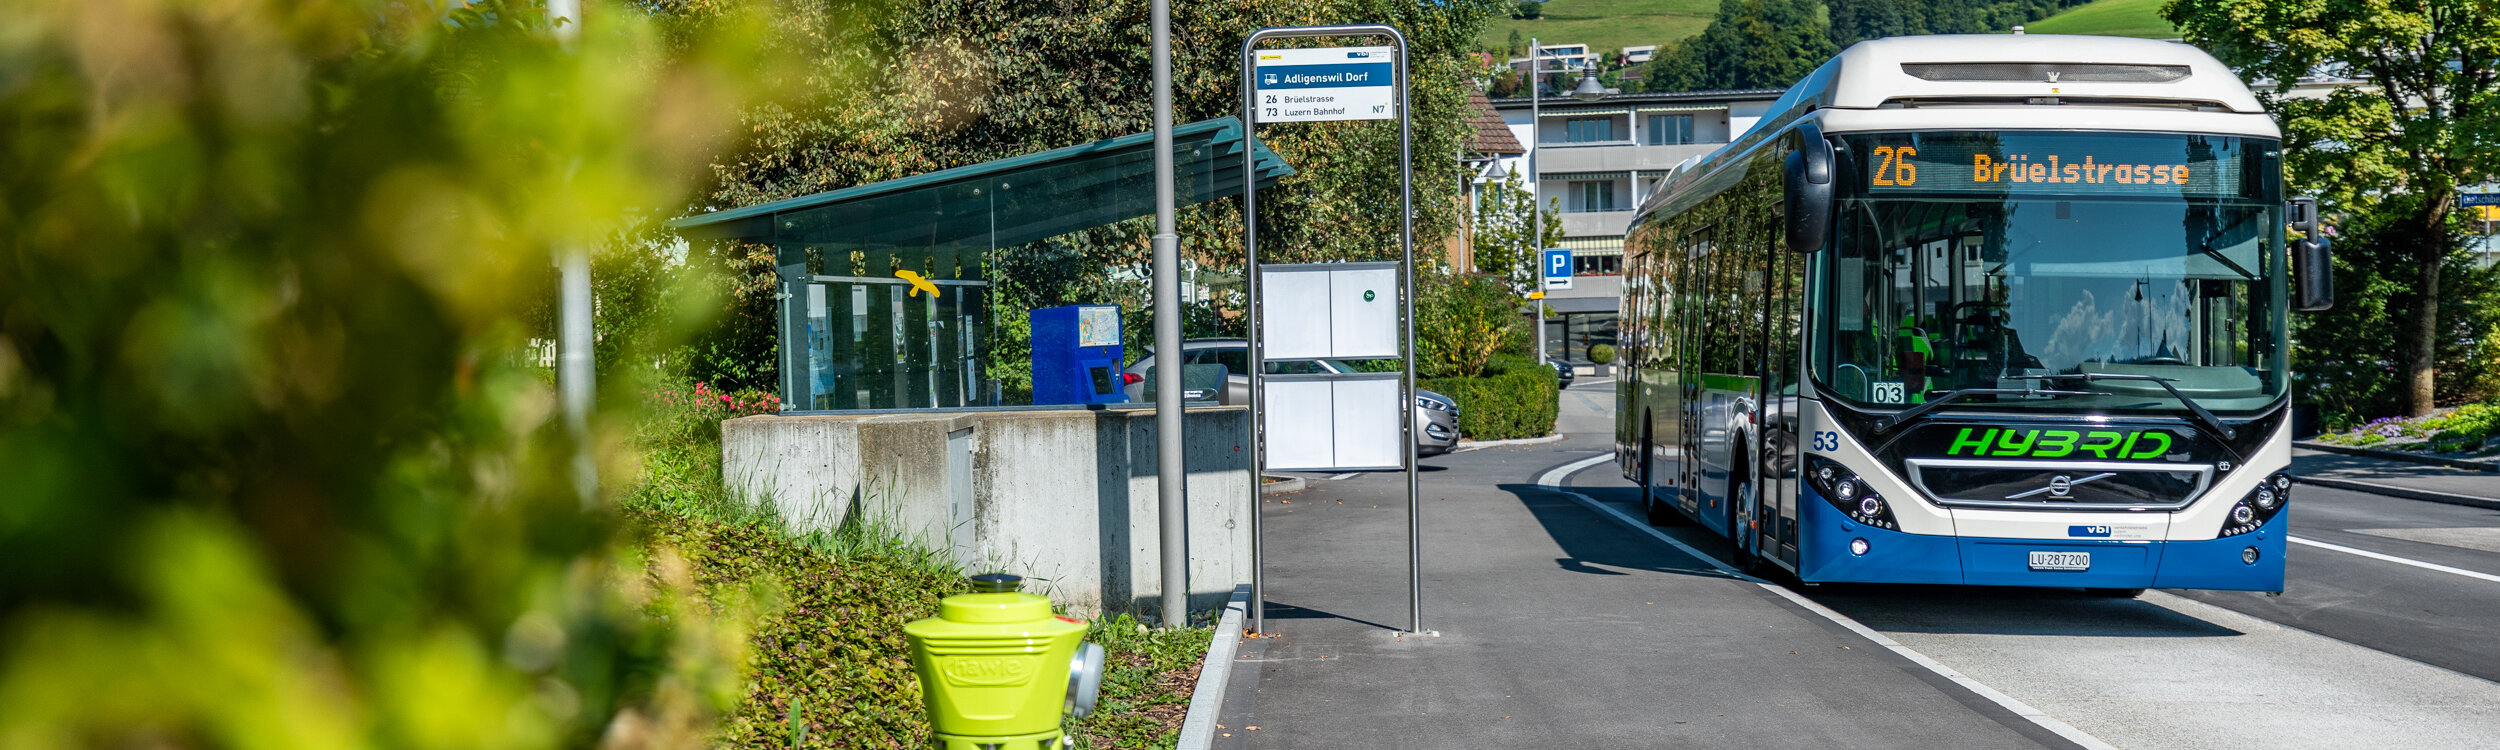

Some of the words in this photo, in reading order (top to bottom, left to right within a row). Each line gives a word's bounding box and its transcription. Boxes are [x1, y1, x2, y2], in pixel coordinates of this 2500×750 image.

[1284, 72, 1343, 85] Adligenswil
[1345, 72, 1369, 82] Dorf
[1266, 95, 1278, 104] 26
[1284, 95, 1334, 104] Brüelstrasse
[1266, 108, 1278, 117] 73
[1284, 108, 1312, 117] Luzern
[1313, 107, 1345, 116] Bahnhof
[1372, 105, 1385, 114] N7
[1872, 146, 1917, 186] 26
[1974, 154, 2189, 185] Brüelstrasse
[1552, 254, 1565, 275] P
[1875, 387, 1902, 403] 03
[1813, 431, 1839, 452] 53
[1947, 427, 2172, 459] HYBRID
[2086, 525, 2110, 534] vbl
[2068, 554, 2088, 567] 200
